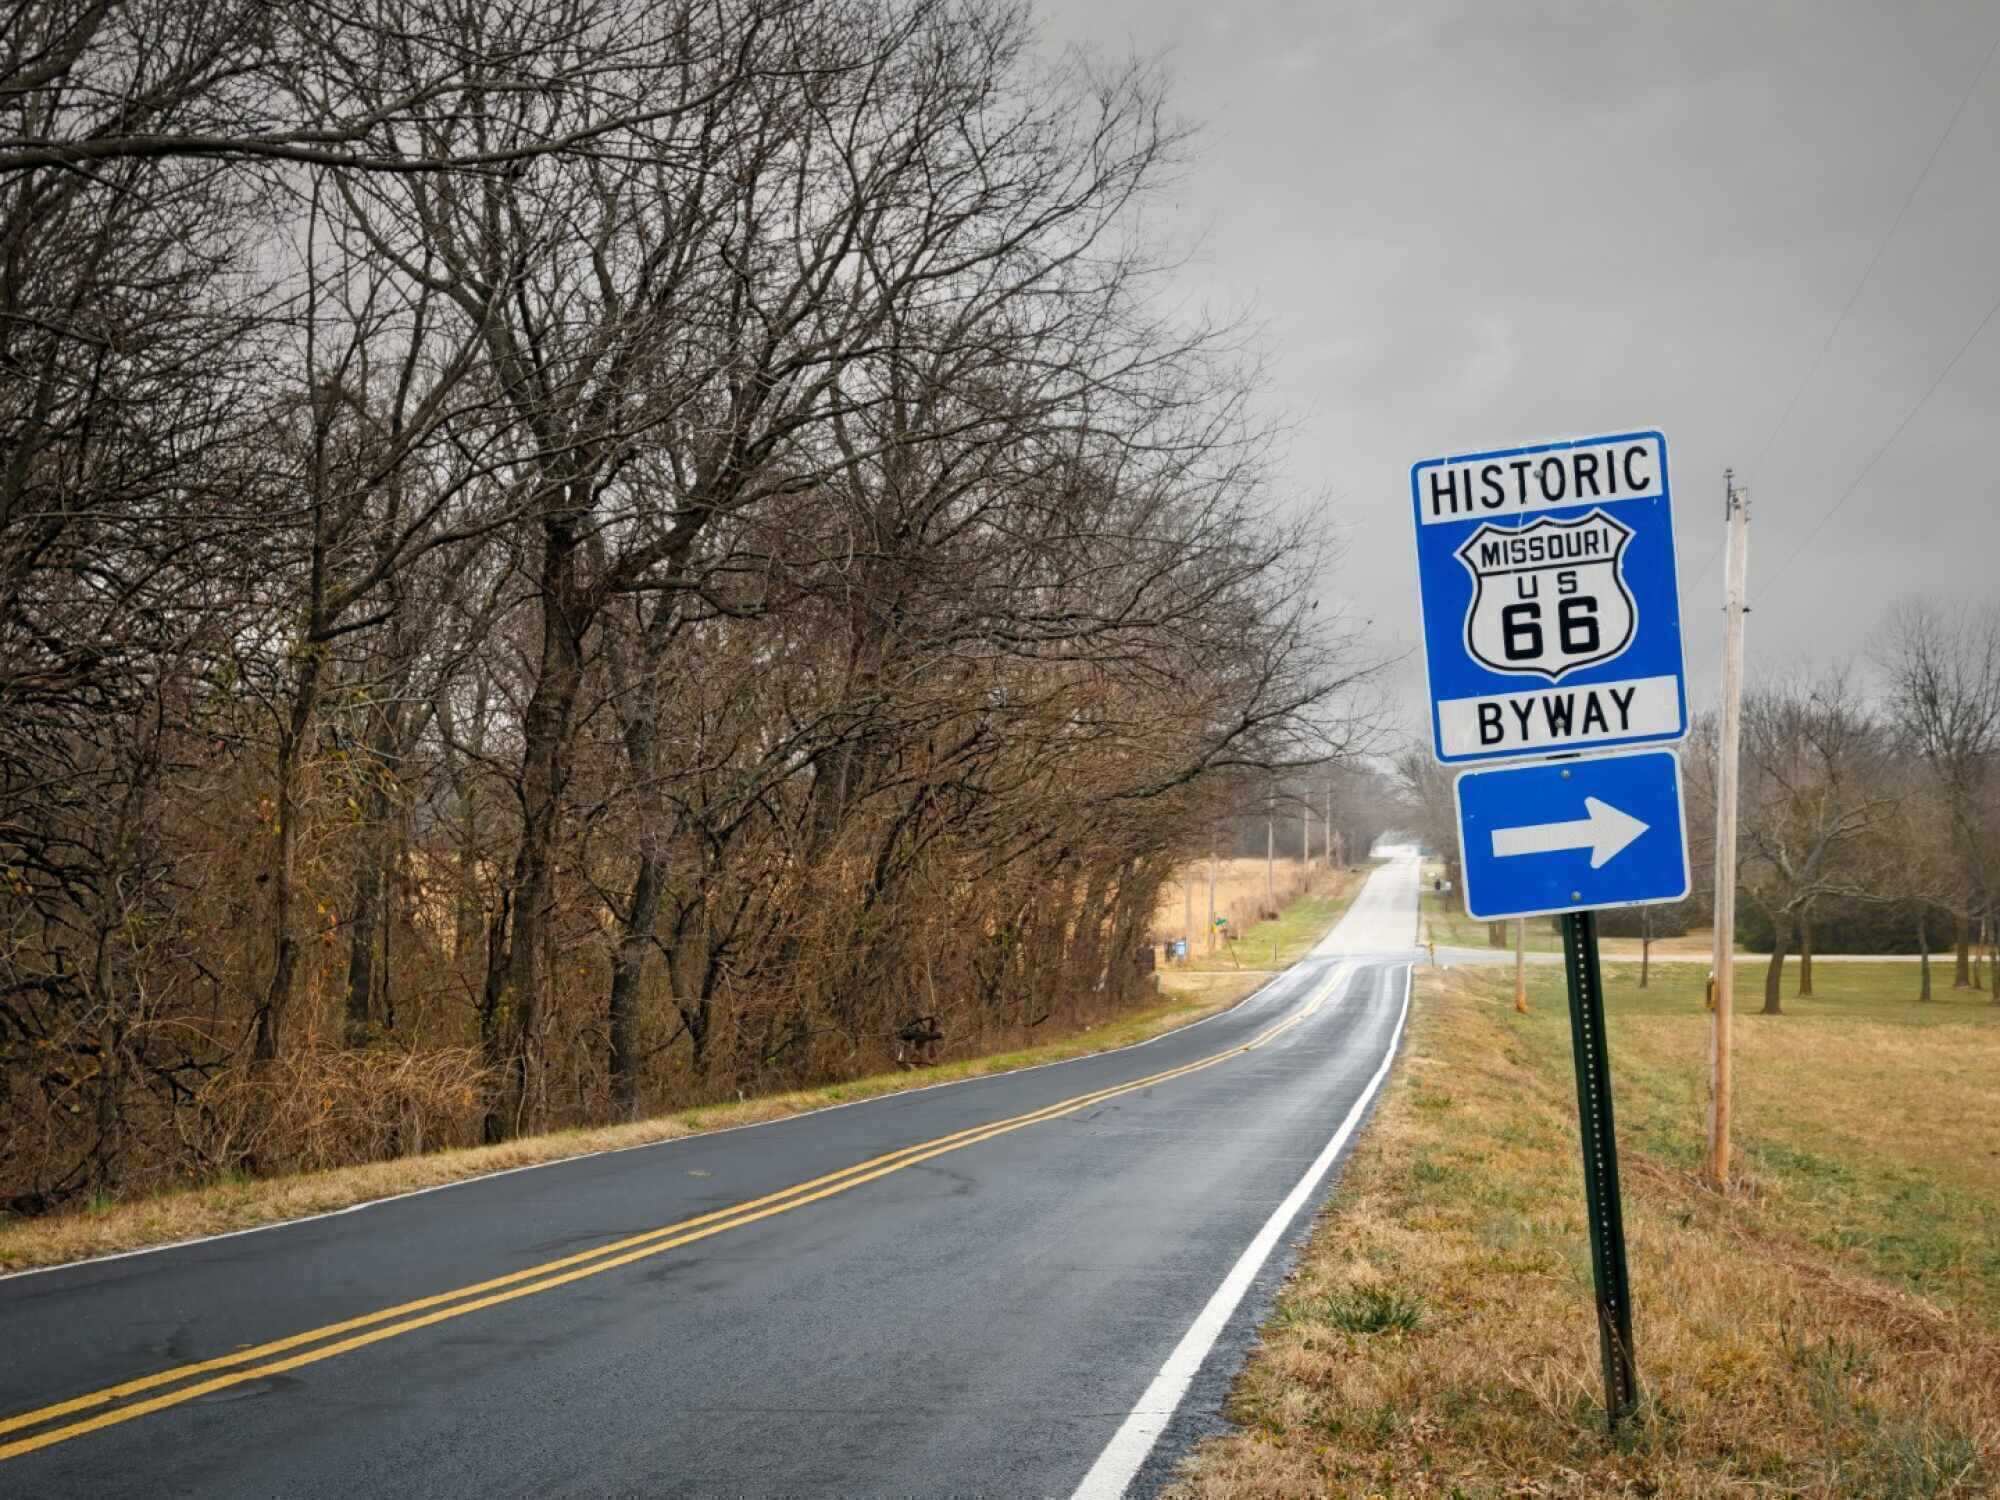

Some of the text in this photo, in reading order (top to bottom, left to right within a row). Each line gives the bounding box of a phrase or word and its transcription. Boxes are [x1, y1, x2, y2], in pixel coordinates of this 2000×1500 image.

[1431, 446, 1650, 515] HISTORIC
[1481, 529, 1609, 567] MISSOURI
[1502, 597, 1600, 660] 66
[1478, 687, 1637, 745] BYWAY
